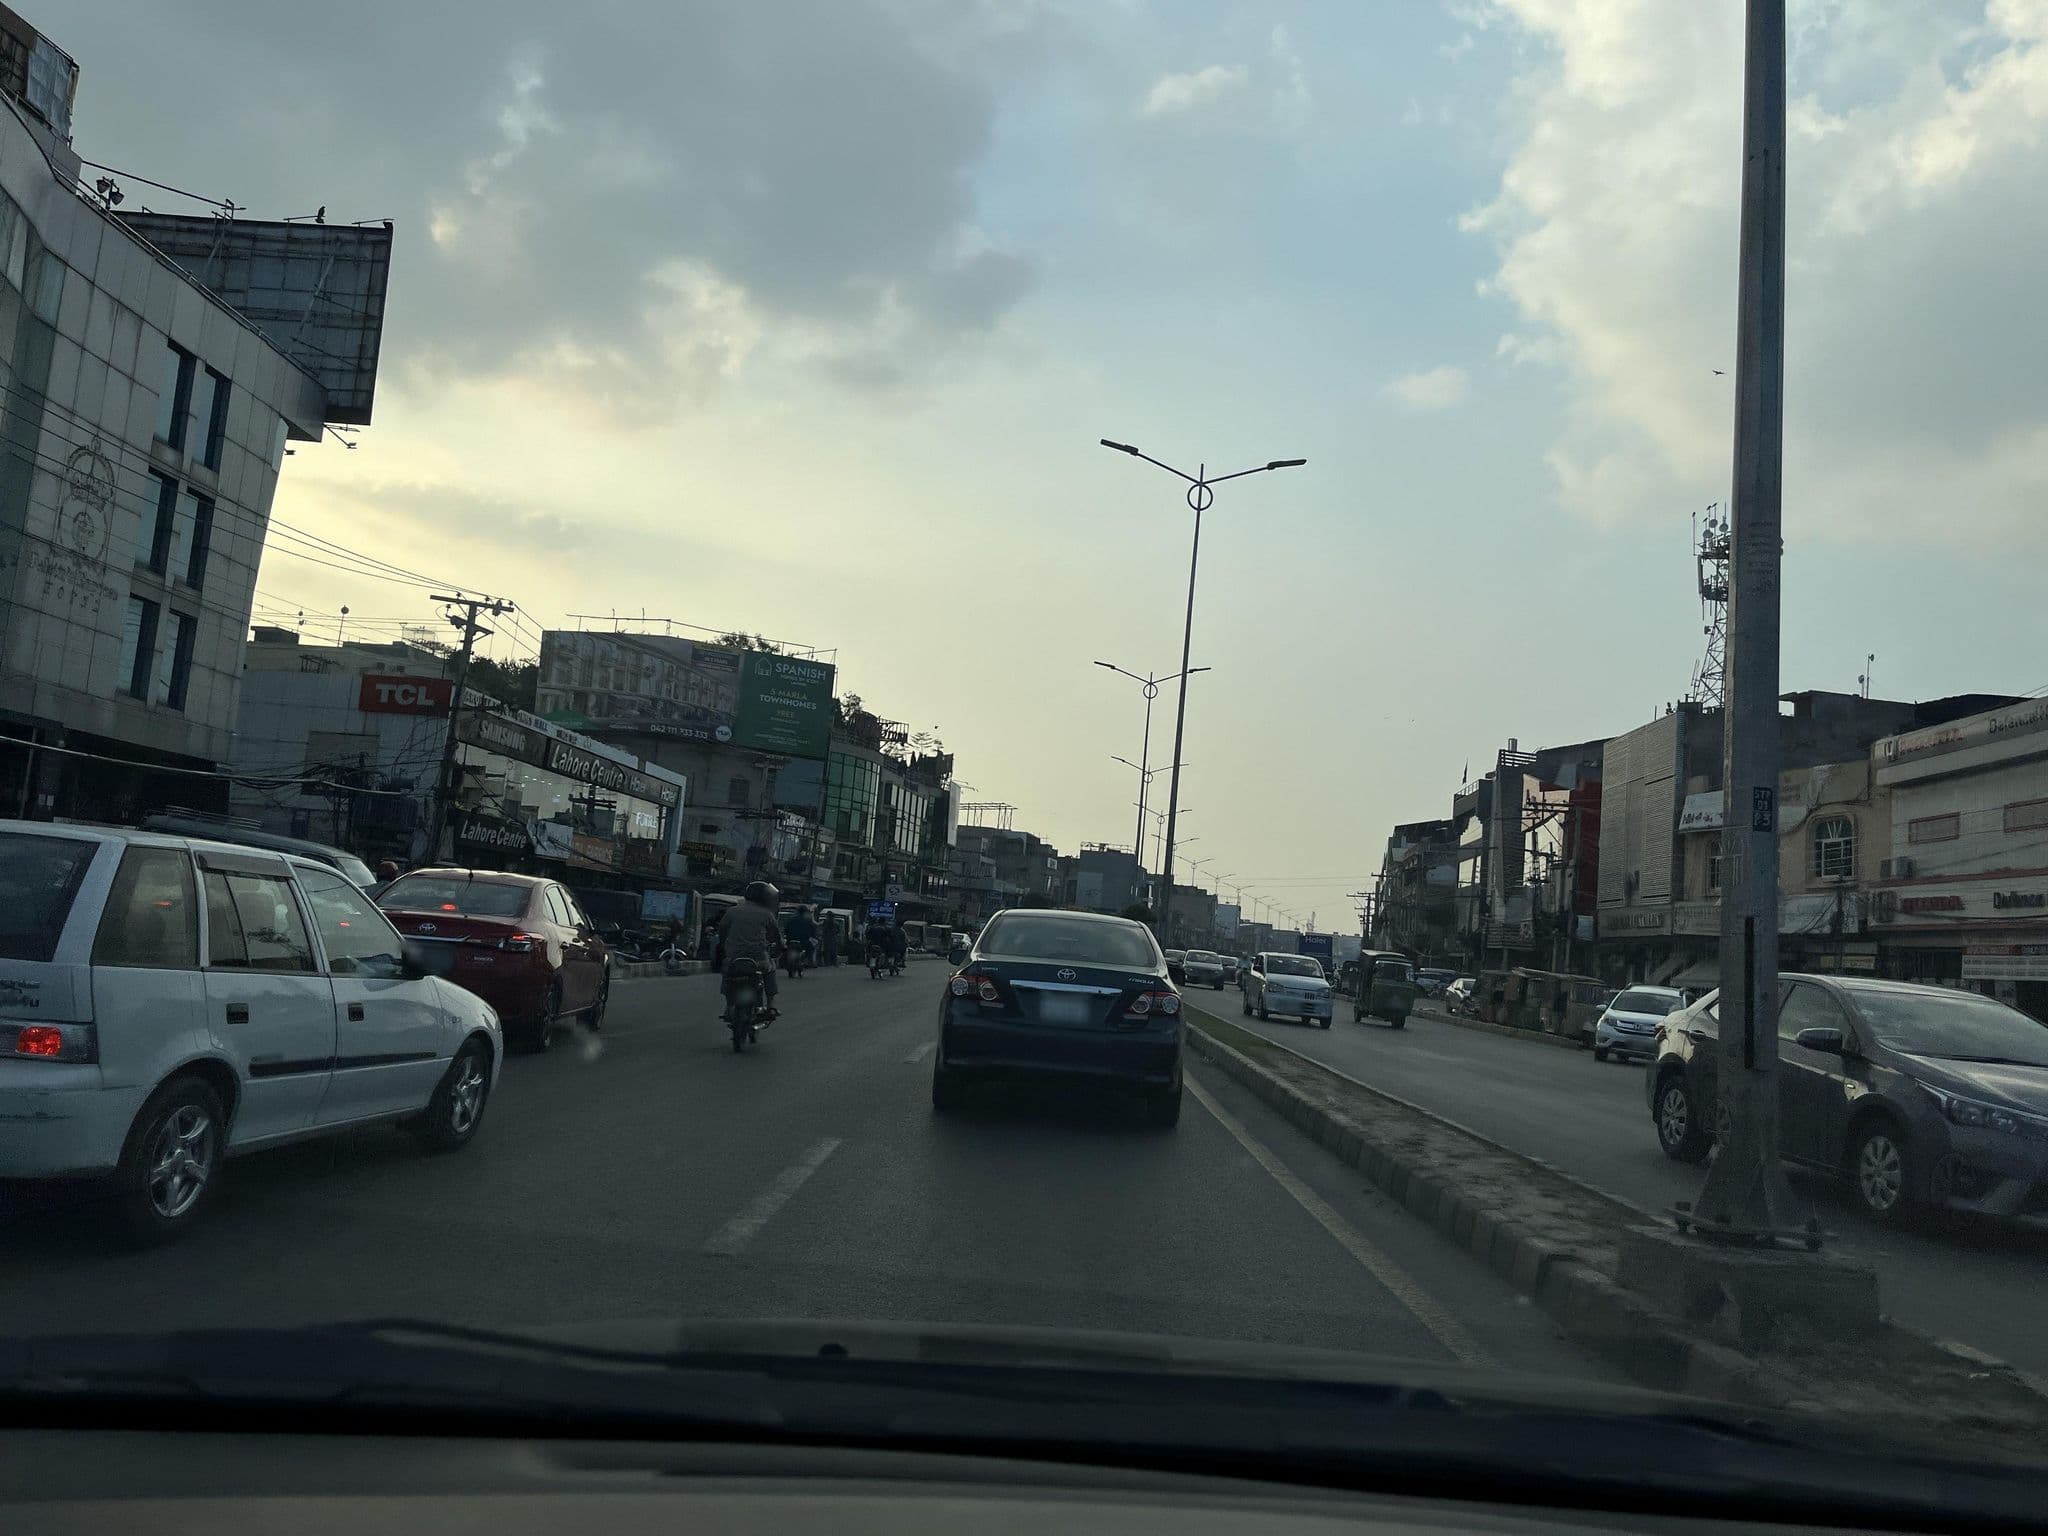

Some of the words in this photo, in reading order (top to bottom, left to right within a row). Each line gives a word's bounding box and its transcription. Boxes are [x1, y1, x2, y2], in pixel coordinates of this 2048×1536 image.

[775, 662, 826, 680] SPANISH
[375, 683, 434, 706] TCL
[760, 694, 817, 710] TOWNHOMES
[778, 689, 807, 700] MARLA
[480, 720, 526, 752] SAMSUNG
[551, 744, 590, 778] Lahore
[590, 759, 624, 788] Centre
[460, 820, 497, 846] Lahore
[496, 826, 527, 848] Centre
[1304, 936, 1328, 945] Haier
